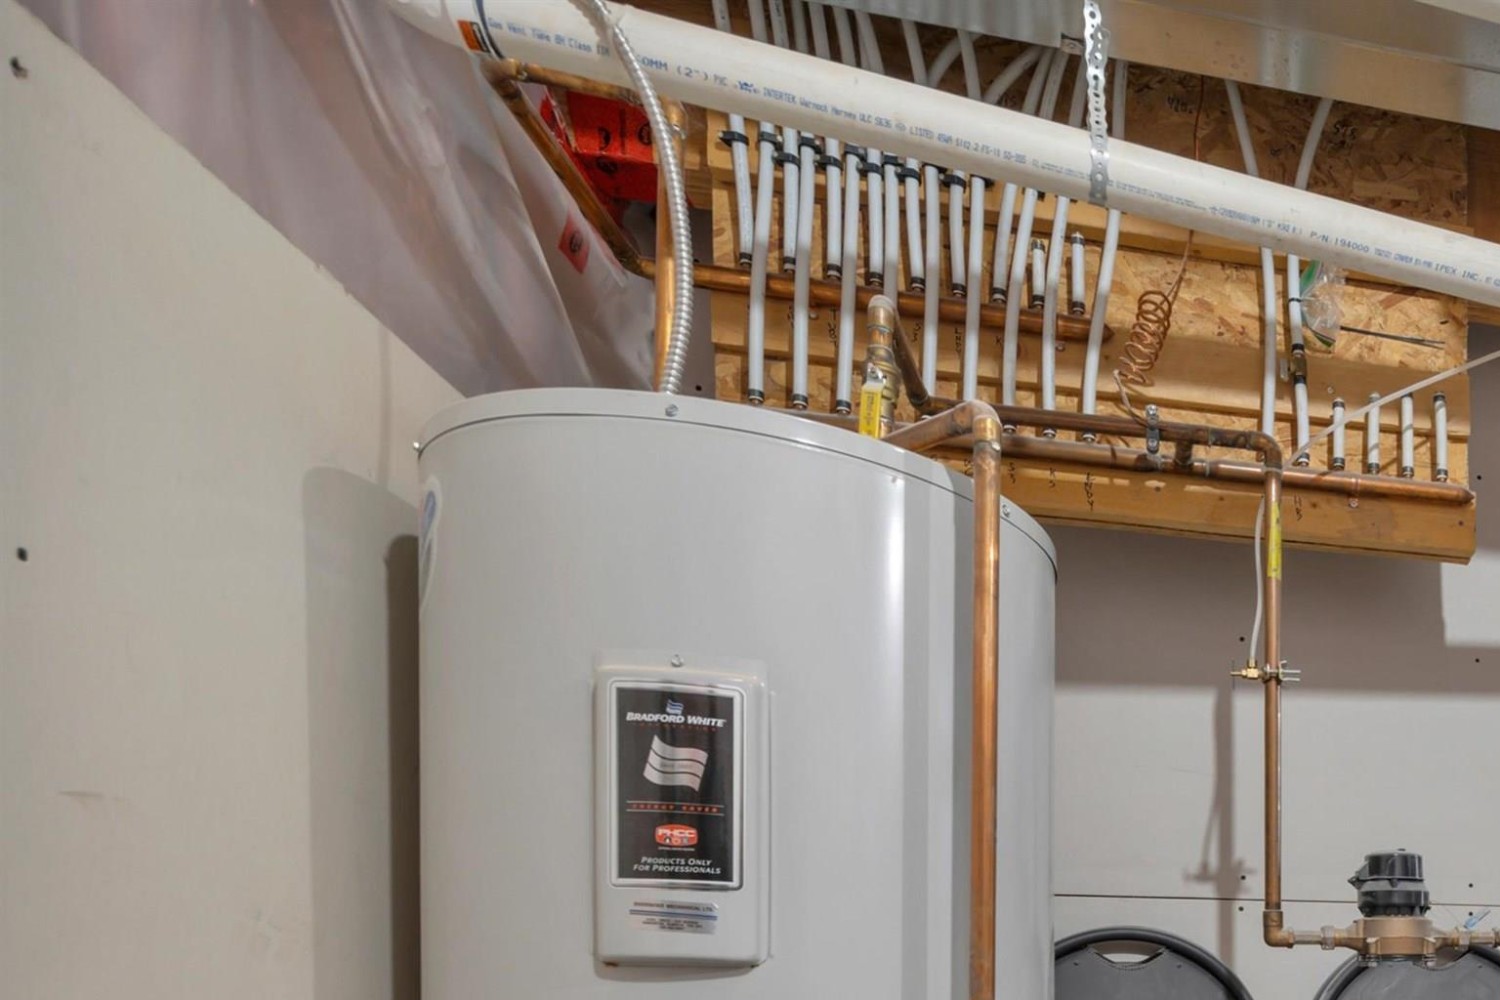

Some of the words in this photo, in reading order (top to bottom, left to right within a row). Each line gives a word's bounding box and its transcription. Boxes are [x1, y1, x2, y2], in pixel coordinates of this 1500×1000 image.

[626, 711, 685, 724] BRADFORD
[687, 714, 725, 728] WHITE
[641, 856, 686, 866] PRODUCTS
[688, 858, 712, 866] ONLY
[633, 864, 650, 872] FOR
[652, 864, 722, 875] PROFESSIONALS
